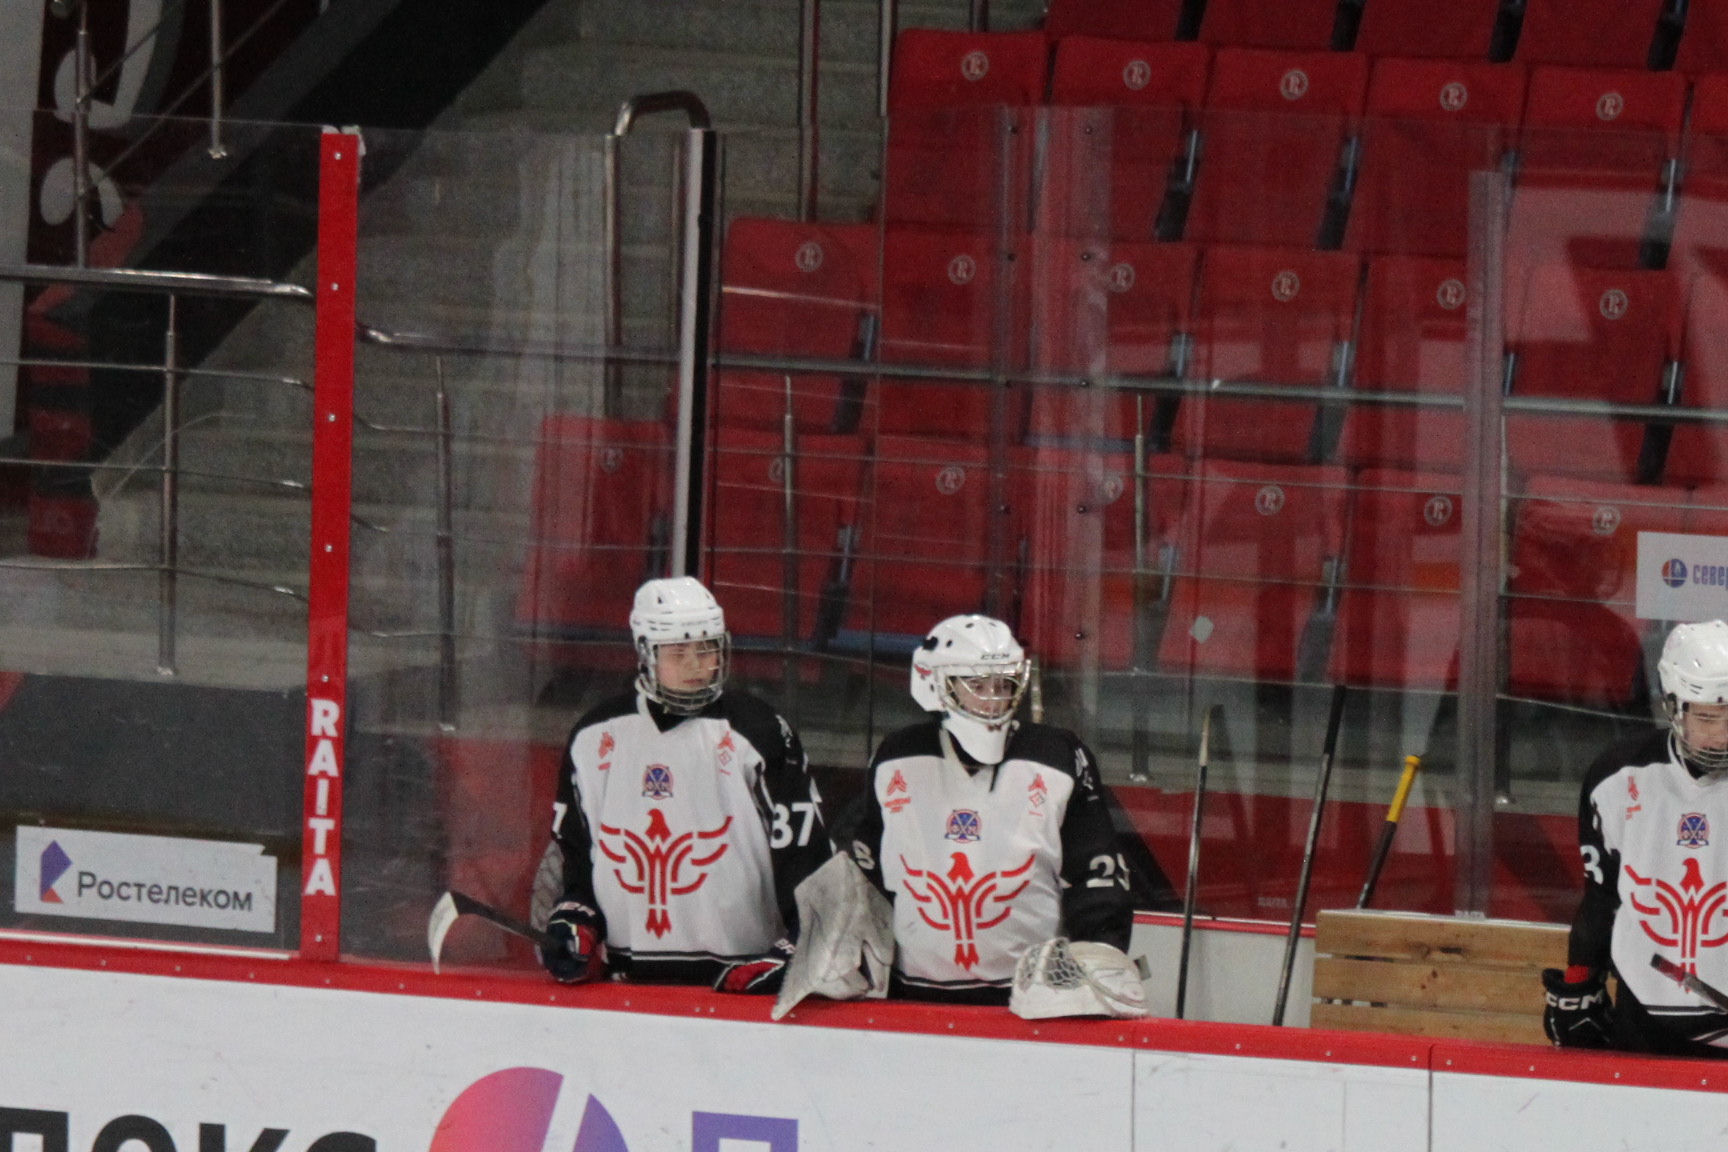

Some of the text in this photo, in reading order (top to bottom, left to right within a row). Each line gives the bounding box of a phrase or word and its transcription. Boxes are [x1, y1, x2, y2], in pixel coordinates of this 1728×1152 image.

[303, 698, 341, 897] RAITA
[769, 801, 815, 849] 37
[76, 870, 253, 912] Ростелеком
